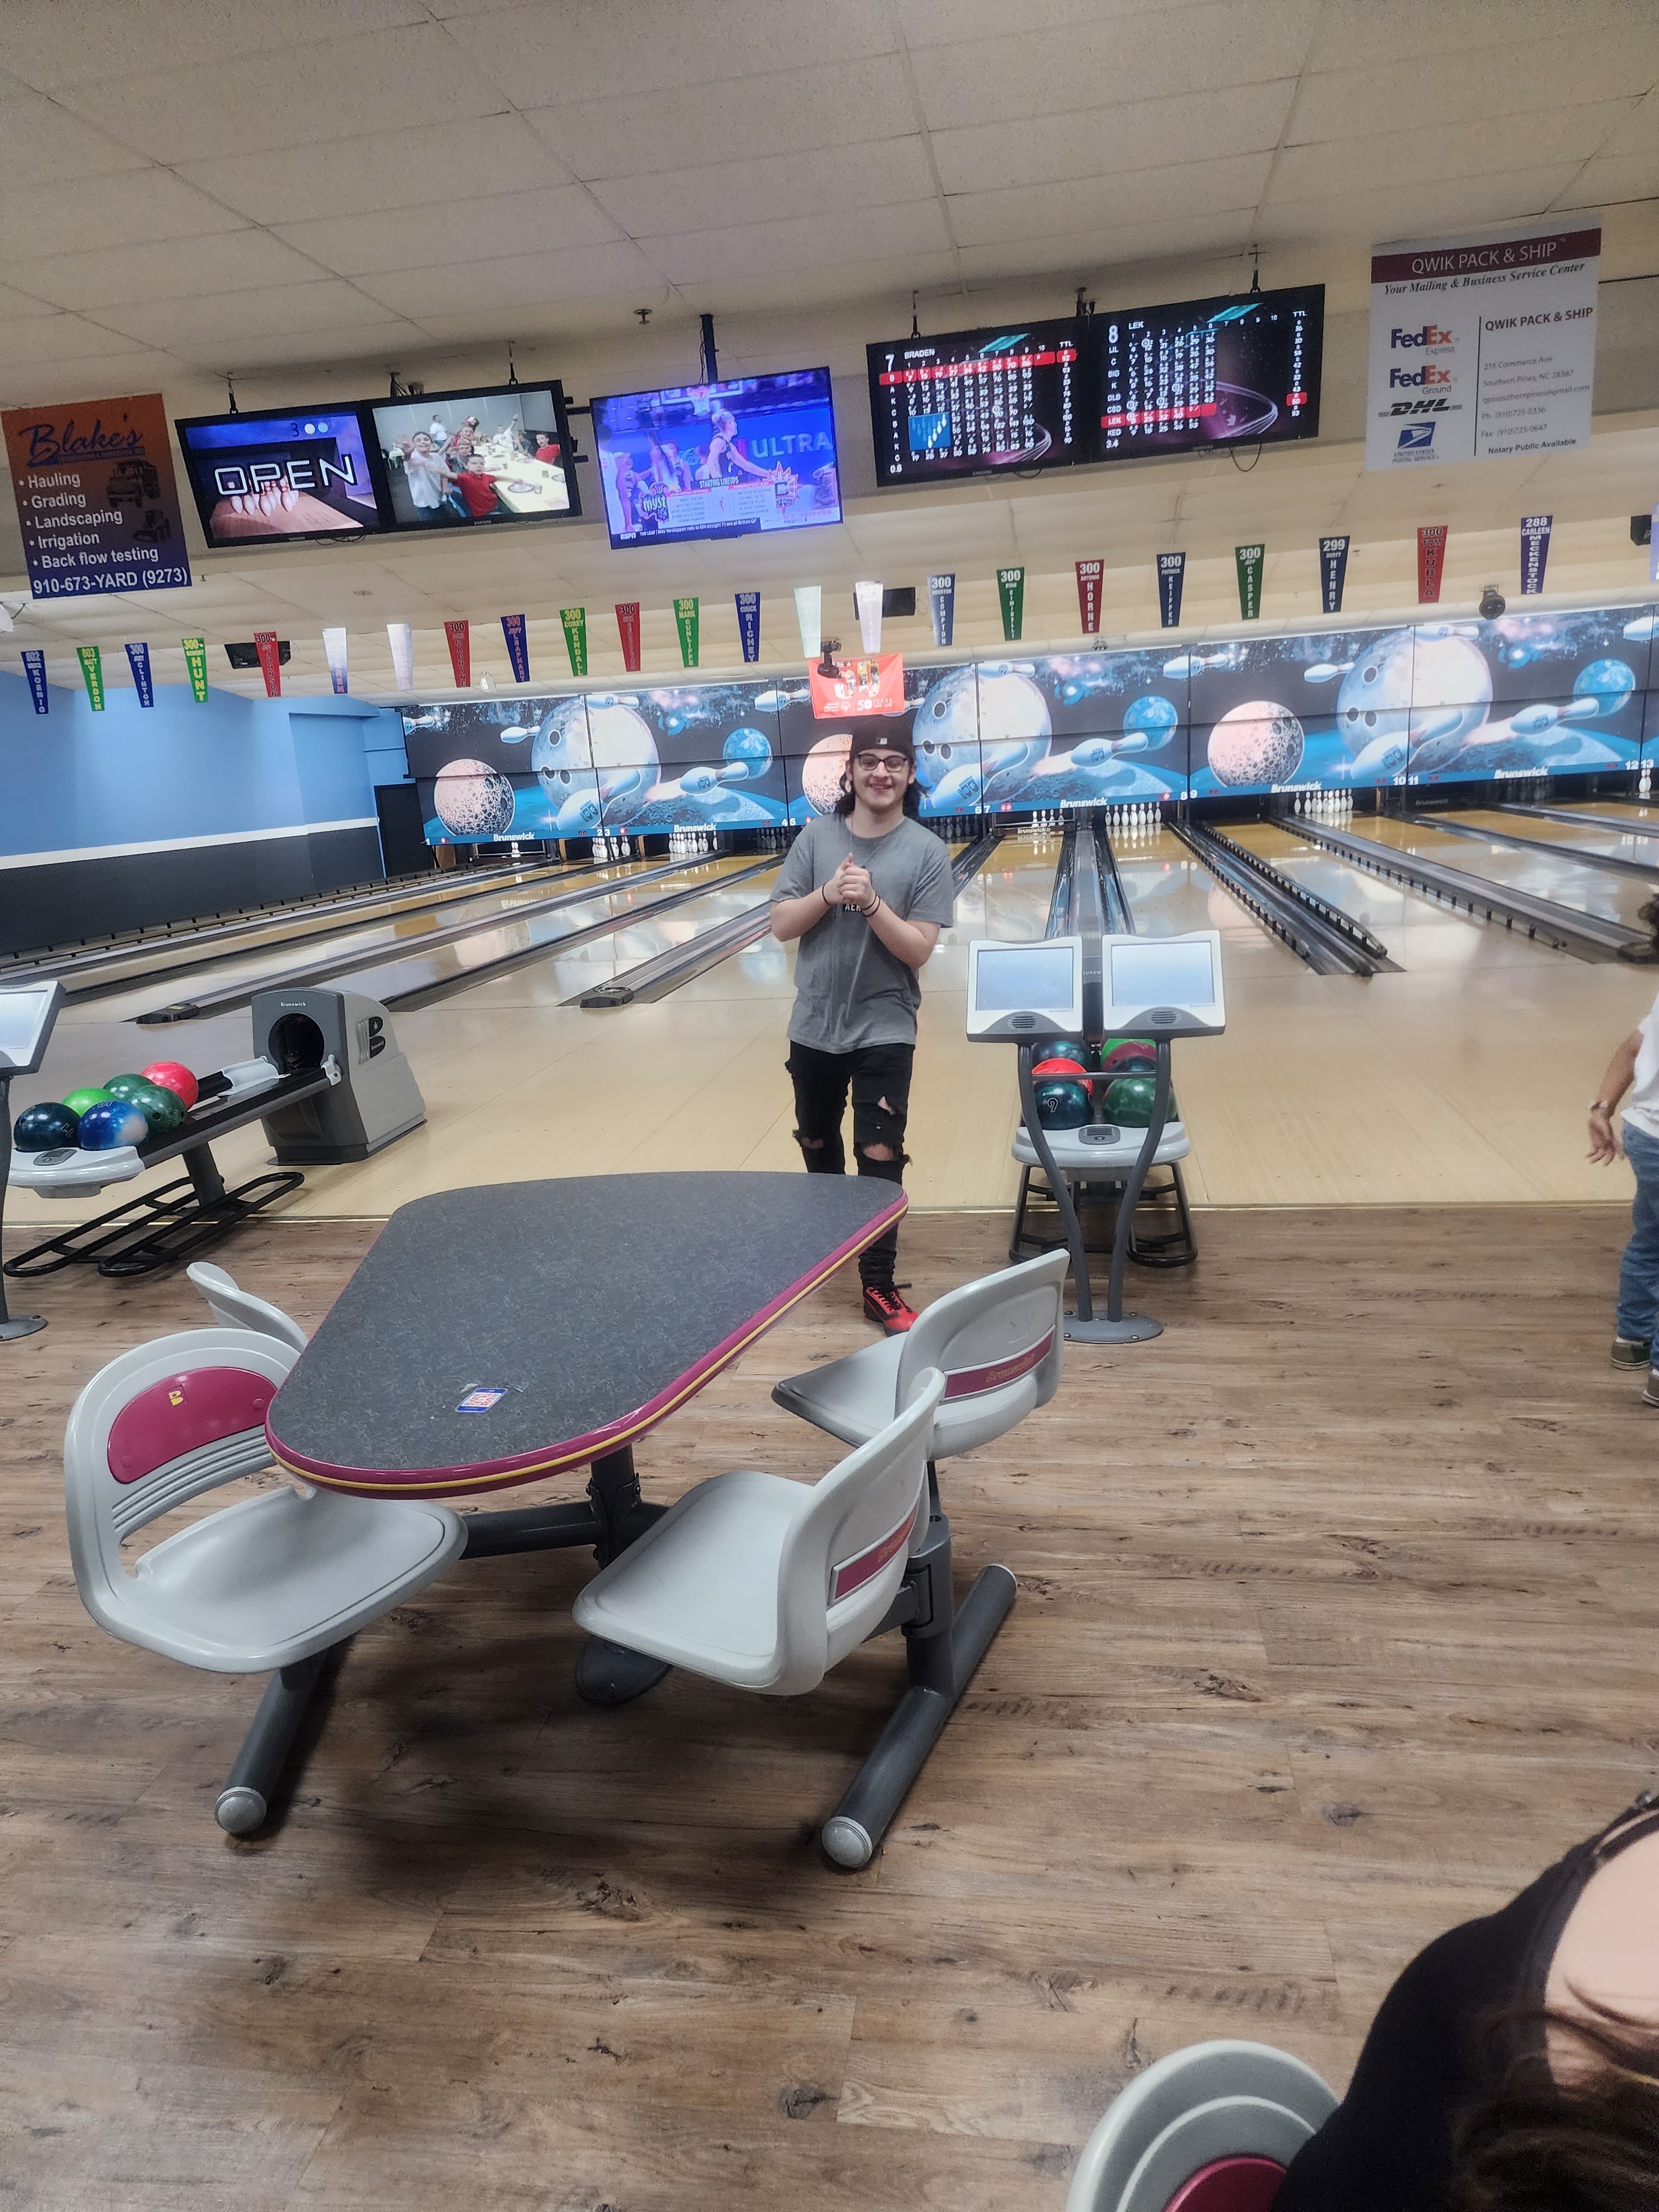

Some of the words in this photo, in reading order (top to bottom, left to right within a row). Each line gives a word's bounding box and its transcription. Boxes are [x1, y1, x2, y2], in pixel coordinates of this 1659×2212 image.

[1412, 254, 1454, 274] QWIK
[1459, 250, 1499, 269] PACK
[1503, 248, 1515, 263] &
[1519, 242, 1557, 262] SHIP
[1384, 284, 1407, 296] Your
[1410, 278, 1447, 292] Mailing
[1451, 278, 1459, 288] &
[1463, 274, 1506, 286] Business
[1510, 268, 1547, 281] Service
[1549, 262, 1585, 274] Center
[1485, 317, 1517, 331] QWIK
[1520, 313, 1551, 326] PACK
[1553, 311, 1562, 321] &
[1566, 307, 1593, 320] SHIP
[1109, 325, 1118, 343] 8
[1129, 321, 1145, 330] LEK
[1391, 325, 1452, 348] FedEx
[1426, 346, 1455, 356] Express
[885, 354, 895, 372] 7
[904, 348, 936, 359] BRADEN
[1390, 364, 1451, 388] FedEx
[1422, 385, 1451, 394] Ground
[1390, 398, 1451, 416] DHL
[290, 422, 300, 437] 3
[18, 414, 144, 467] Blake's
[752, 431, 833, 458] ULTRA
[1515, 443, 1539, 451] Public
[1541, 438, 1577, 448] Available
[29, 473, 81, 489] Hauling
[215, 455, 356, 495] OPEN
[31, 493, 86, 509] Grading
[35, 509, 123, 529] Landscaping
[1526, 517, 1547, 528] 288
[1422, 528, 1443, 538] 300
[1521, 526, 1550, 536] CARLEEN
[38, 532, 100, 550] Irrigation
[1323, 539, 1345, 552] 299
[41, 553, 76, 568] Back
[79, 552, 108, 566] flow
[111, 547, 159, 562] testing
[1239, 547, 1261, 560] 300
[1079, 562, 1100, 575] 300
[1161, 556, 1182, 568] 300
[1000, 570, 1021, 583] 300
[1425, 548, 1436, 597] KUBLA
[33, 571, 137, 594] 910-673-YARD
[142, 567, 187, 588] (9273)
[932, 577, 951, 589] 300
[679, 599, 693, 611] 300
[739, 593, 757, 605] 300
[564, 609, 581, 621] 300
[620, 604, 636, 615] 300
[740, 605, 757, 613] CHUCK
[449, 622, 465, 632] 300
[506, 615, 521, 627] 300
[184, 639, 199, 650] 300
[256, 634, 271, 644] 300
[745, 613, 755, 662] RICHEY
[129, 644, 144, 655] 300
[571, 628, 583, 676] KENDALL
[191, 657, 205, 701] HUNT
[266, 651, 277, 697] JOHNSON
[87, 665, 102, 710] VERDON
[137, 662, 150, 706] CLINTON
[857, 699, 873, 711] 50
[1625, 760, 1638, 770] 12
[1641, 759, 1653, 768] 13
[1393, 776, 1405, 785] 10
[1407, 776, 1418, 785] 11
[1494, 766, 1548, 779] Brunswick
[1180, 791, 1187, 800] 8
[1190, 790, 1197, 799] 9
[1271, 781, 1322, 792] Brunswick
[1060, 797, 1107, 808] Brunswick
[674, 822, 717, 832] Brunswick
[493, 832, 535, 842] Brunswick
